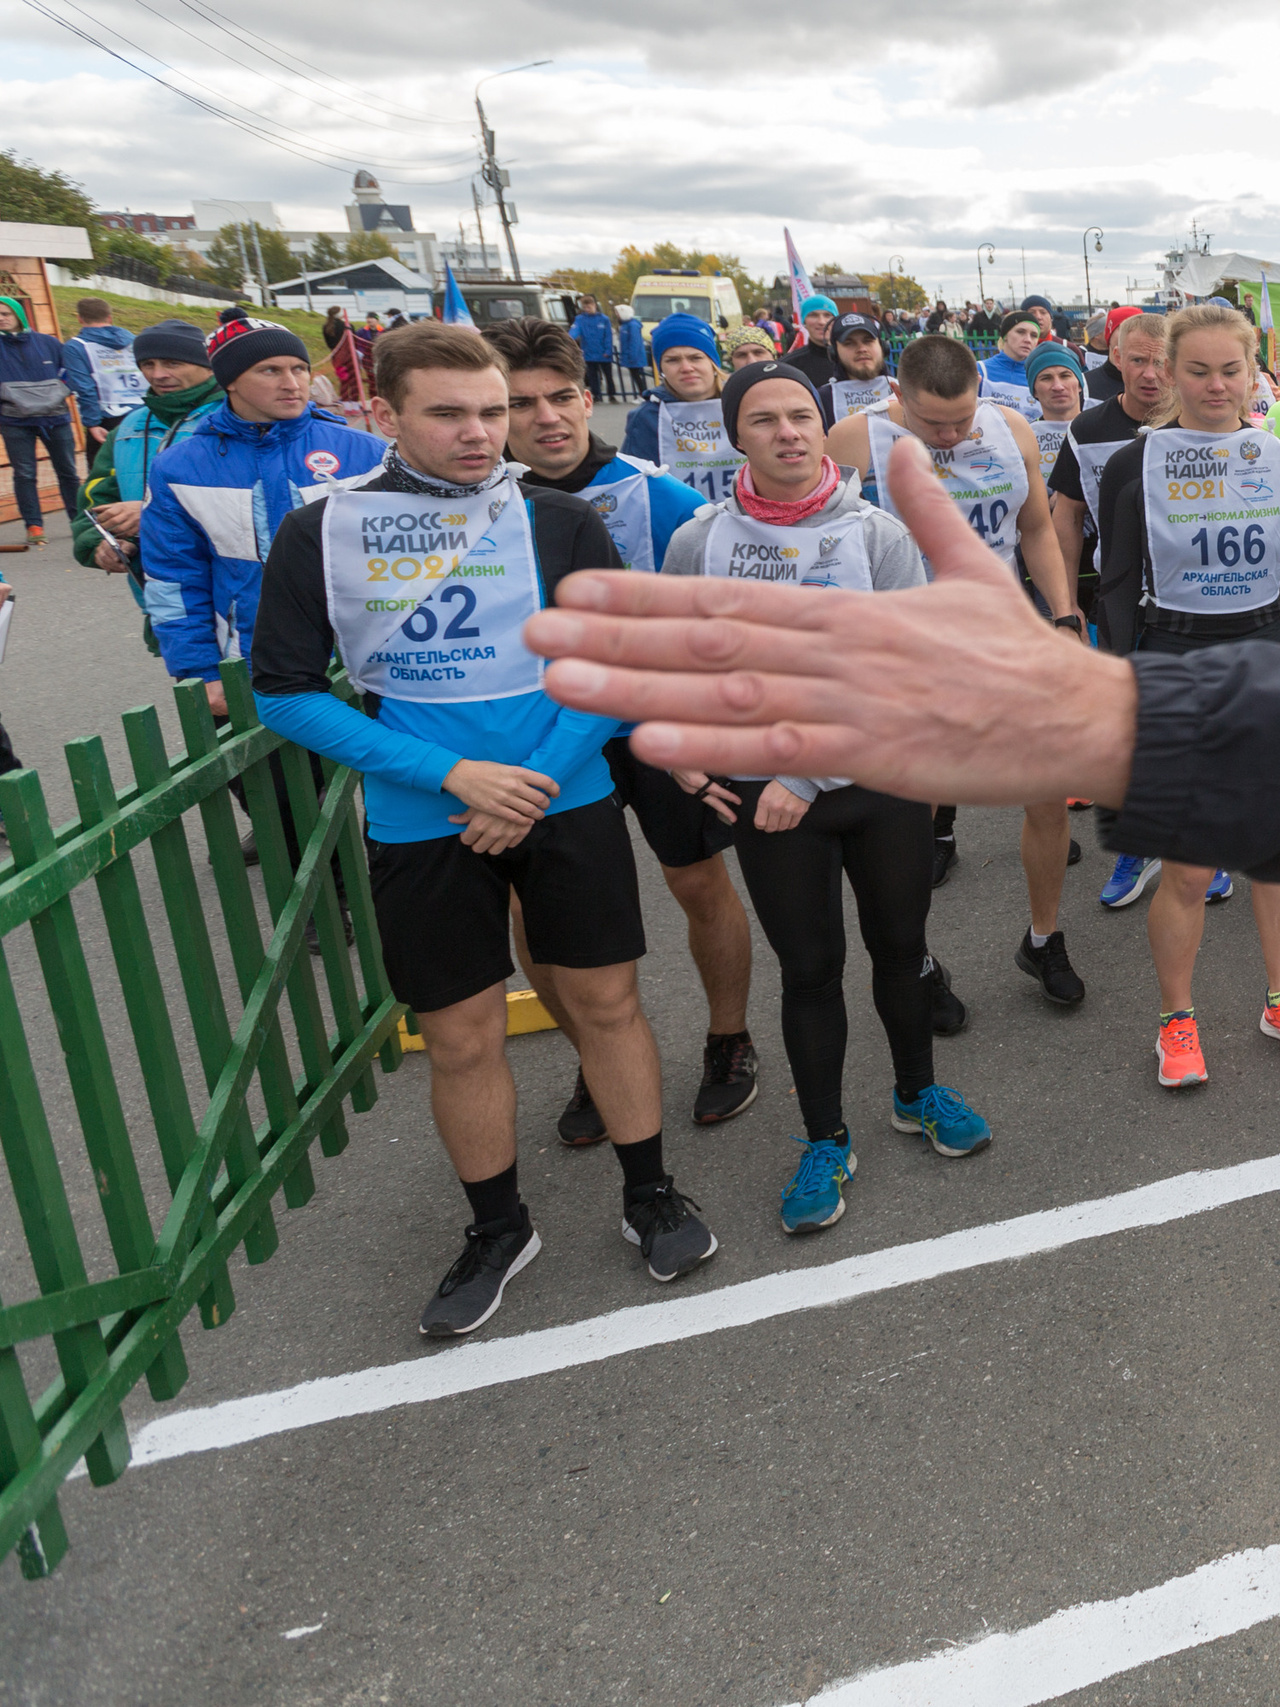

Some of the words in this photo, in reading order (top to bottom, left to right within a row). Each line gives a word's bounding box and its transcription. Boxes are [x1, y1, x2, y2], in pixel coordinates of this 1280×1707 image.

[676, 438, 717, 452] 2021
[1165, 446, 1214, 463] КРОСС
[1165, 462, 1228, 479] НАЦИИ
[980, 482, 1014, 499] ЖИЗНИ
[1167, 480, 1225, 501] 2021
[362, 512, 442, 533] КРОСС
[1168, 513, 1199, 523] СПОРТ
[1208, 511, 1244, 521] НОРМА
[1246, 506, 1280, 519] ЖИЗНИ
[362, 531, 468, 555] НАЦИИ
[1191, 524, 1266, 567] 166
[731, 542, 783, 562] КРОСС
[728, 559, 797, 581] НАЦИИ
[1182, 568, 1268, 583] АРХАНГЕЛЬСКАЯ
[1201, 585, 1251, 596] ОБЛАСТЬ
[365, 599, 417, 612] СПОРТ
[390, 667, 466, 681] ОБЛАСТЬ
